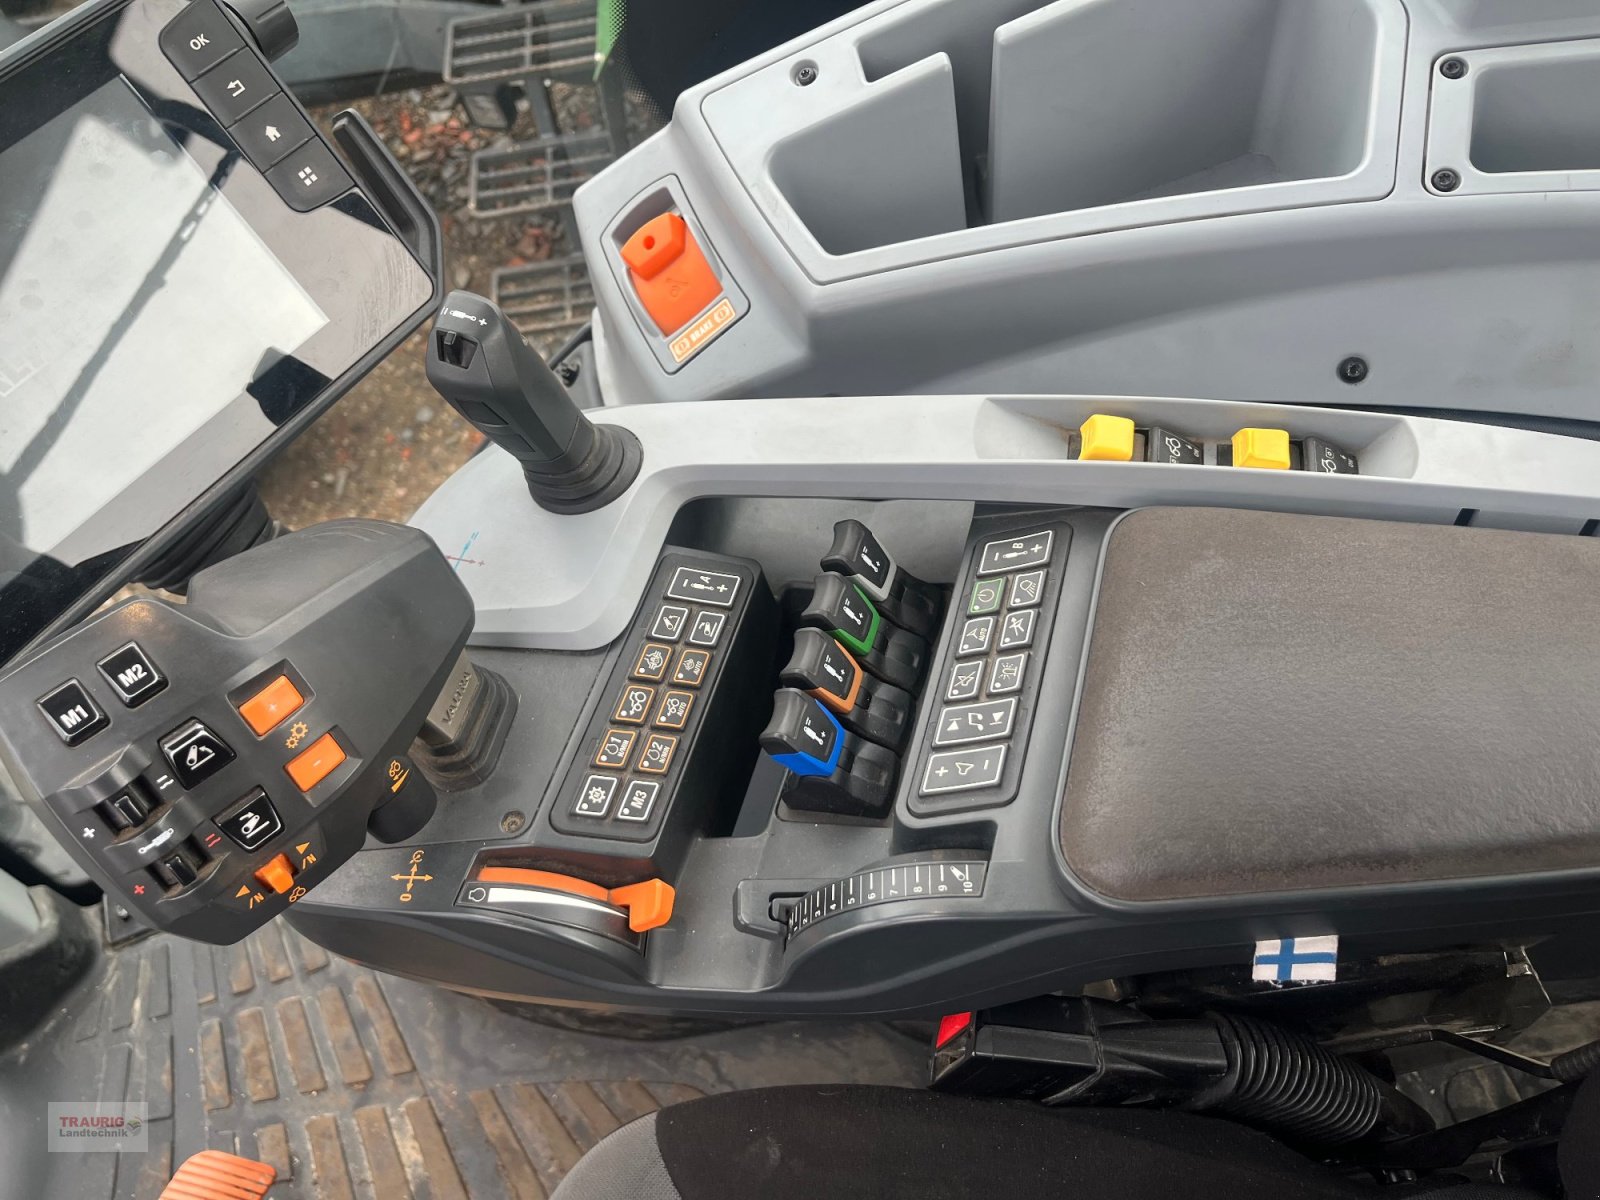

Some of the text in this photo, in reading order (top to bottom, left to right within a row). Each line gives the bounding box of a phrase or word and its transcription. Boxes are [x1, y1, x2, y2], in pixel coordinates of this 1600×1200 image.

[189, 33, 210, 51] OK
[689, 318, 713, 343] BRAKE
[700, 575, 711, 584] A
[978, 627, 987, 642] AUTO
[117, 663, 147, 688] M2
[693, 660, 703, 676] AUTO
[59, 704, 89, 729] M1
[676, 701, 687, 717] AUTO
[651, 741, 664, 752] 2
[630, 790, 647, 809] M3
[802, 917, 808, 925] 2
[814, 910, 821, 918] 3
[847, 897, 855, 905] 5
[867, 892, 876, 900] 6
[938, 884, 948, 892] 9
[963, 881, 973, 893] 10
